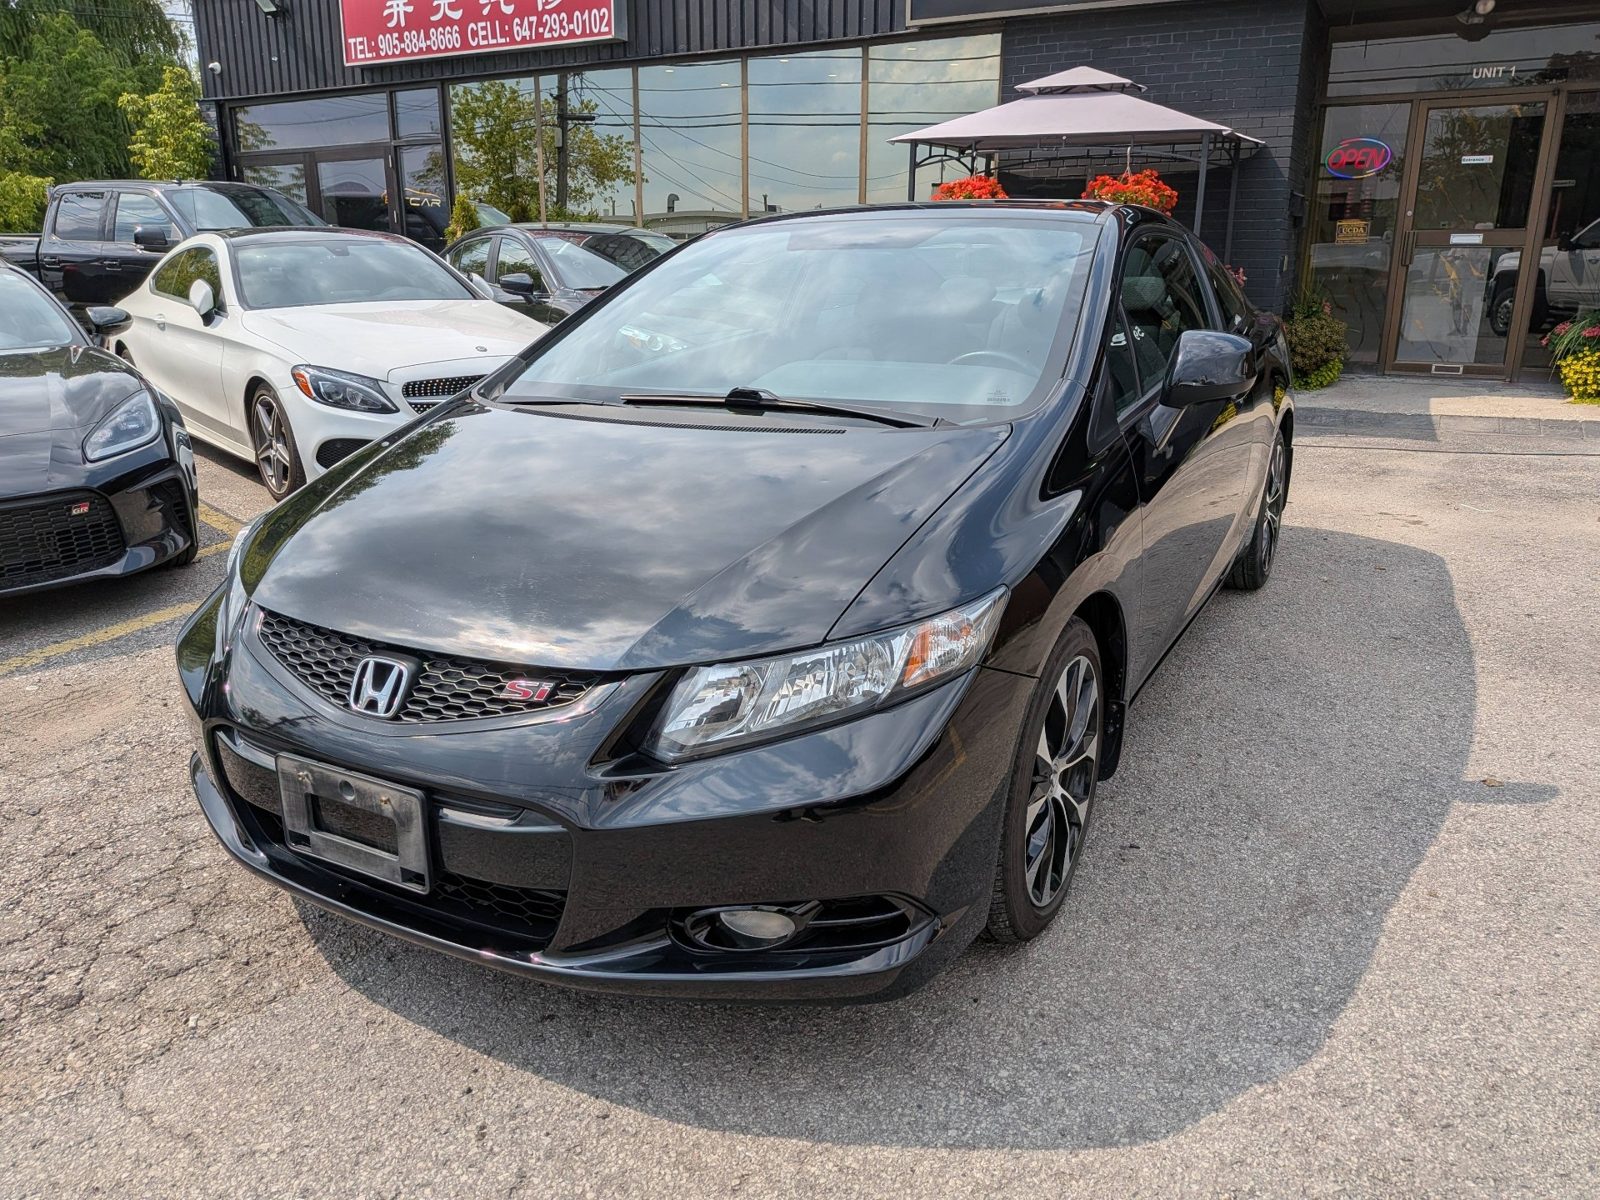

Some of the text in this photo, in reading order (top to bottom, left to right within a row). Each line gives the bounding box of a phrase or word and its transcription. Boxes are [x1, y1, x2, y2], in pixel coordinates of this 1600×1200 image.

[348, 7, 610, 60] TEL: 905-884-8666 CELL: 647-293-0102
[1472, 65, 1516, 79] UNIT 1
[1328, 148, 1386, 169] OPEN
[500, 680, 554, 701] Si
